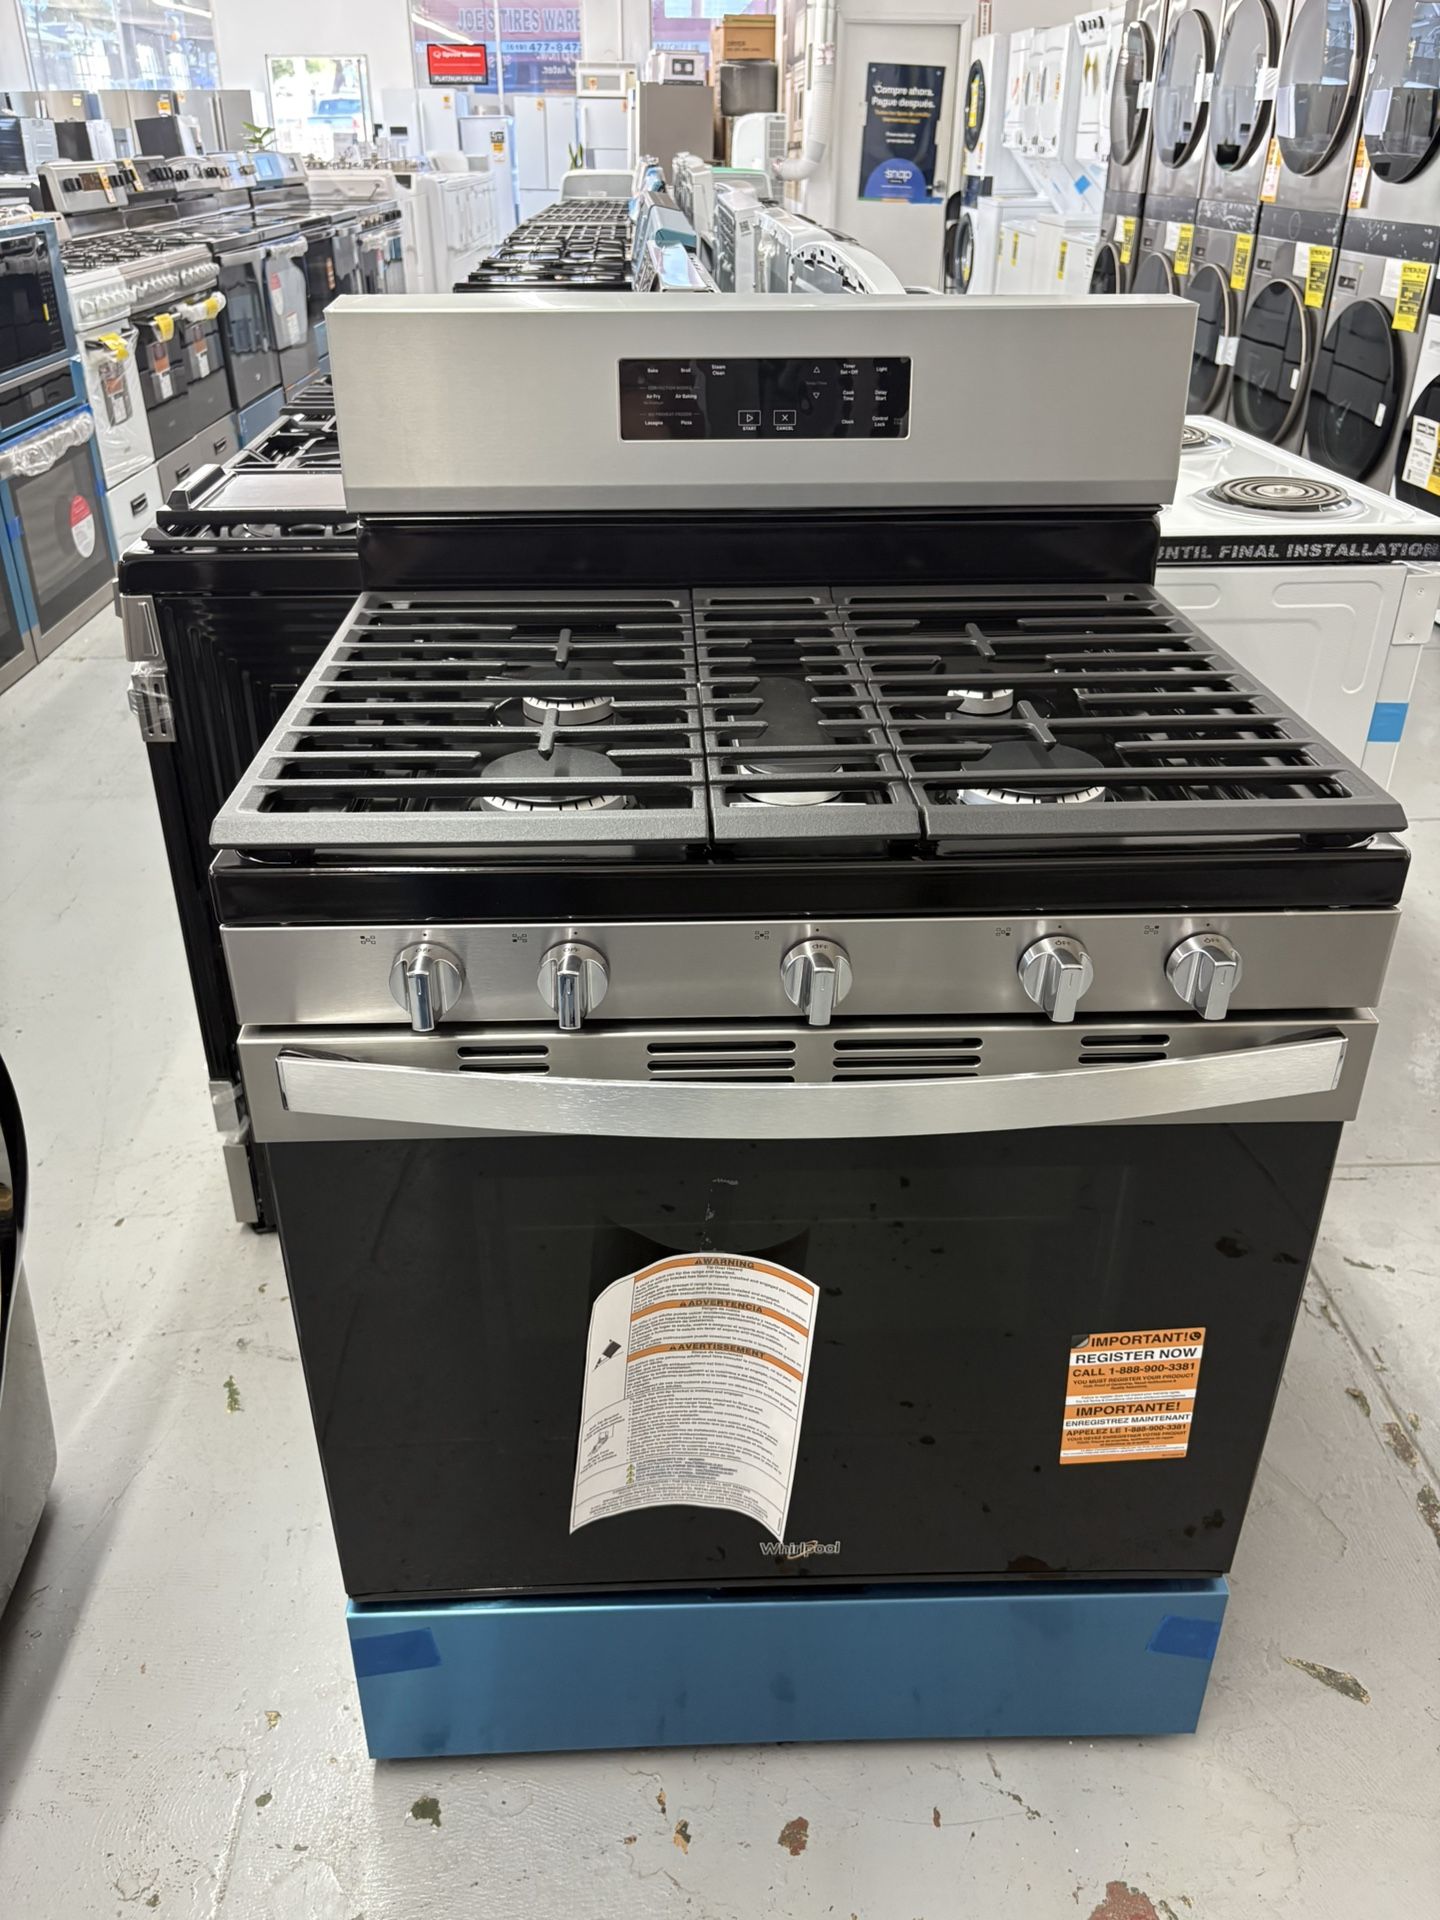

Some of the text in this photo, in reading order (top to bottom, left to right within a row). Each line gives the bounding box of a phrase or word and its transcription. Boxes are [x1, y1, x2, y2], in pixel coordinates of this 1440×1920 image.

[500, 9, 540, 32] TIRES
[529, 43, 580, 51] 477-847
[874, 84, 908, 96] Compre
[871, 96, 898, 108] Pague
[1218, 545, 1279, 559] FINAL
[1286, 543, 1440, 558] INSTALLATION
[703, 1257, 754, 1270] WARNING
[688, 1299, 763, 1313] ADVERTENCIA
[1091, 1332, 1188, 1347] IMPORTANT!
[678, 1343, 764, 1359] AVERTISSEMENT
[1075, 1347, 1197, 1364] REGISTER NOW
[1073, 1362, 1195, 1377] CALL 1-888-900-3381
[1108, 1375, 1141, 1383] REGISTER
[1076, 1402, 1180, 1416] IMPORTANTE!
[1065, 1414, 1191, 1427] ENREGISTREZ MAINTENANT
[1066, 1427, 1107, 1436] APPELEZ
[1124, 1424, 1186, 1433] 1-888-900-3381
[759, 1541, 840, 1558] Whirlpool
